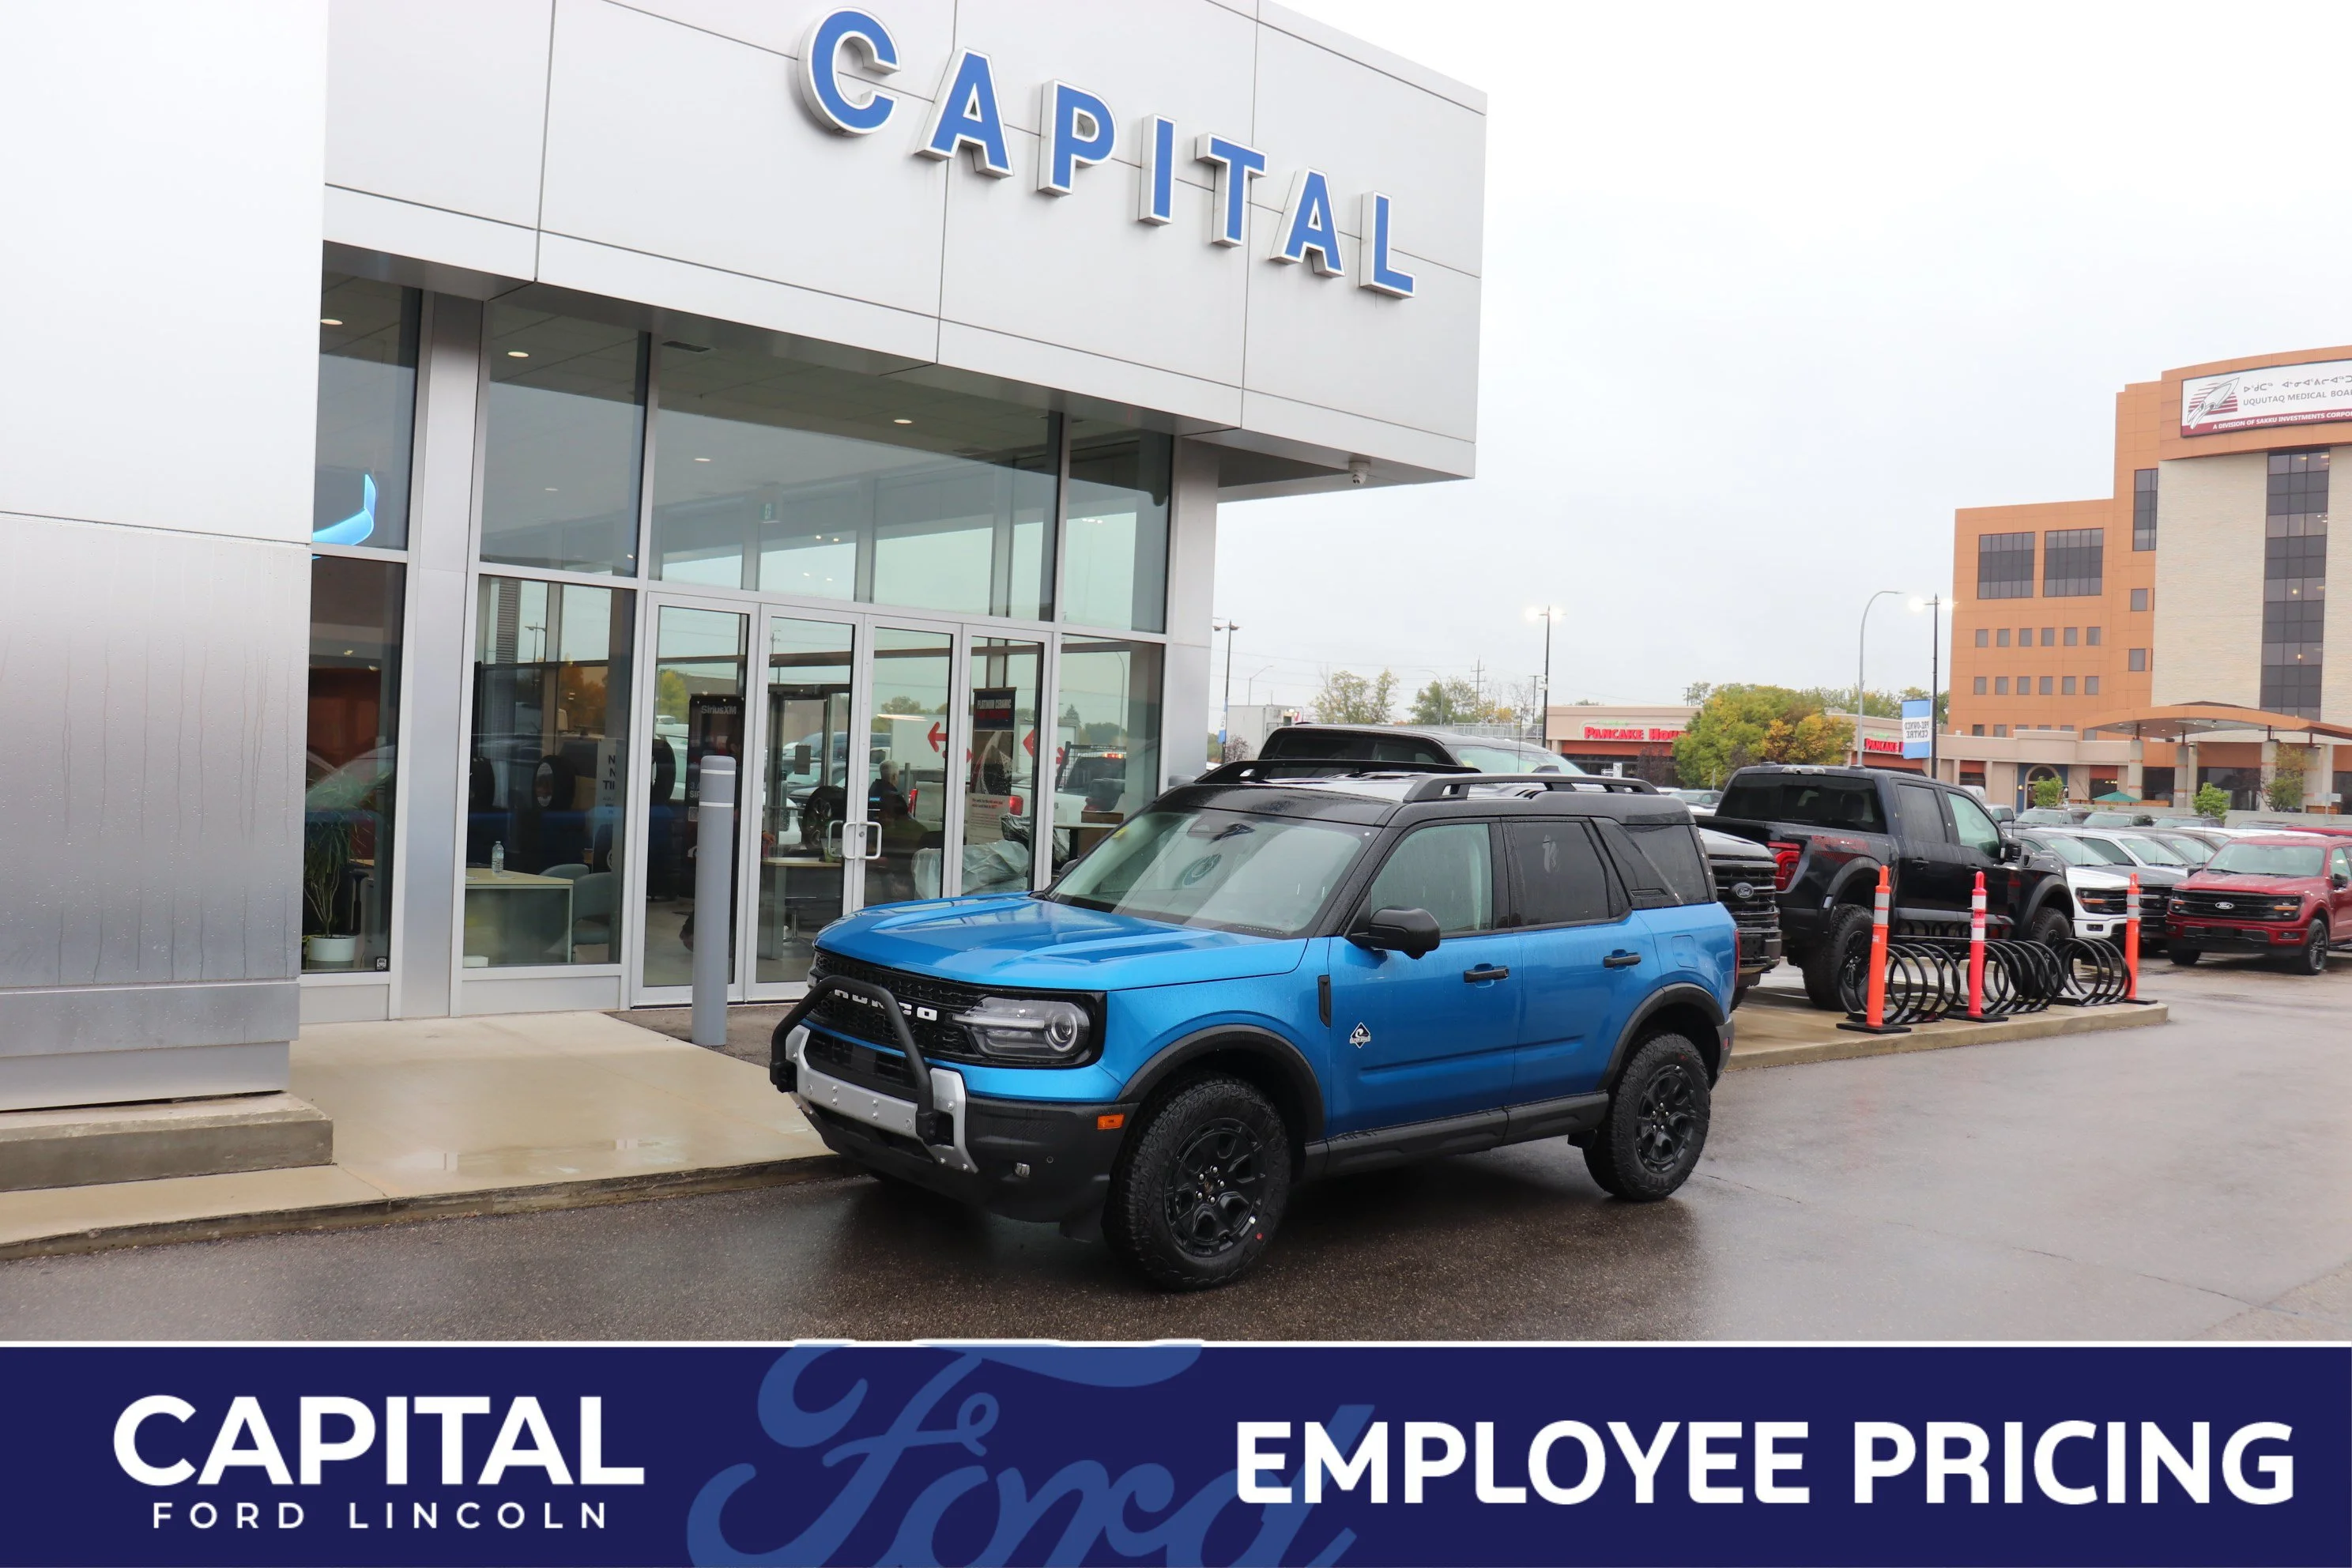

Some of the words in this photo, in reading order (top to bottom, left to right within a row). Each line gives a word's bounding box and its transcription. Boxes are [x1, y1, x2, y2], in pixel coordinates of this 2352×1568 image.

[800, 7, 1415, 298] CAPITAL
[2243, 394, 2286, 406] UQUUTAQ
[2287, 391, 2327, 401] MEDICAL
[2218, 420, 2245, 429] DIVISION
[2256, 416, 2277, 425] SAKKU
[2278, 413, 2325, 423] INVESTMENTS
[701, 705, 737, 714] SiriusXM
[1584, 726, 1644, 740] PANCAKE
[1864, 737, 1899, 752] PANCAKE
